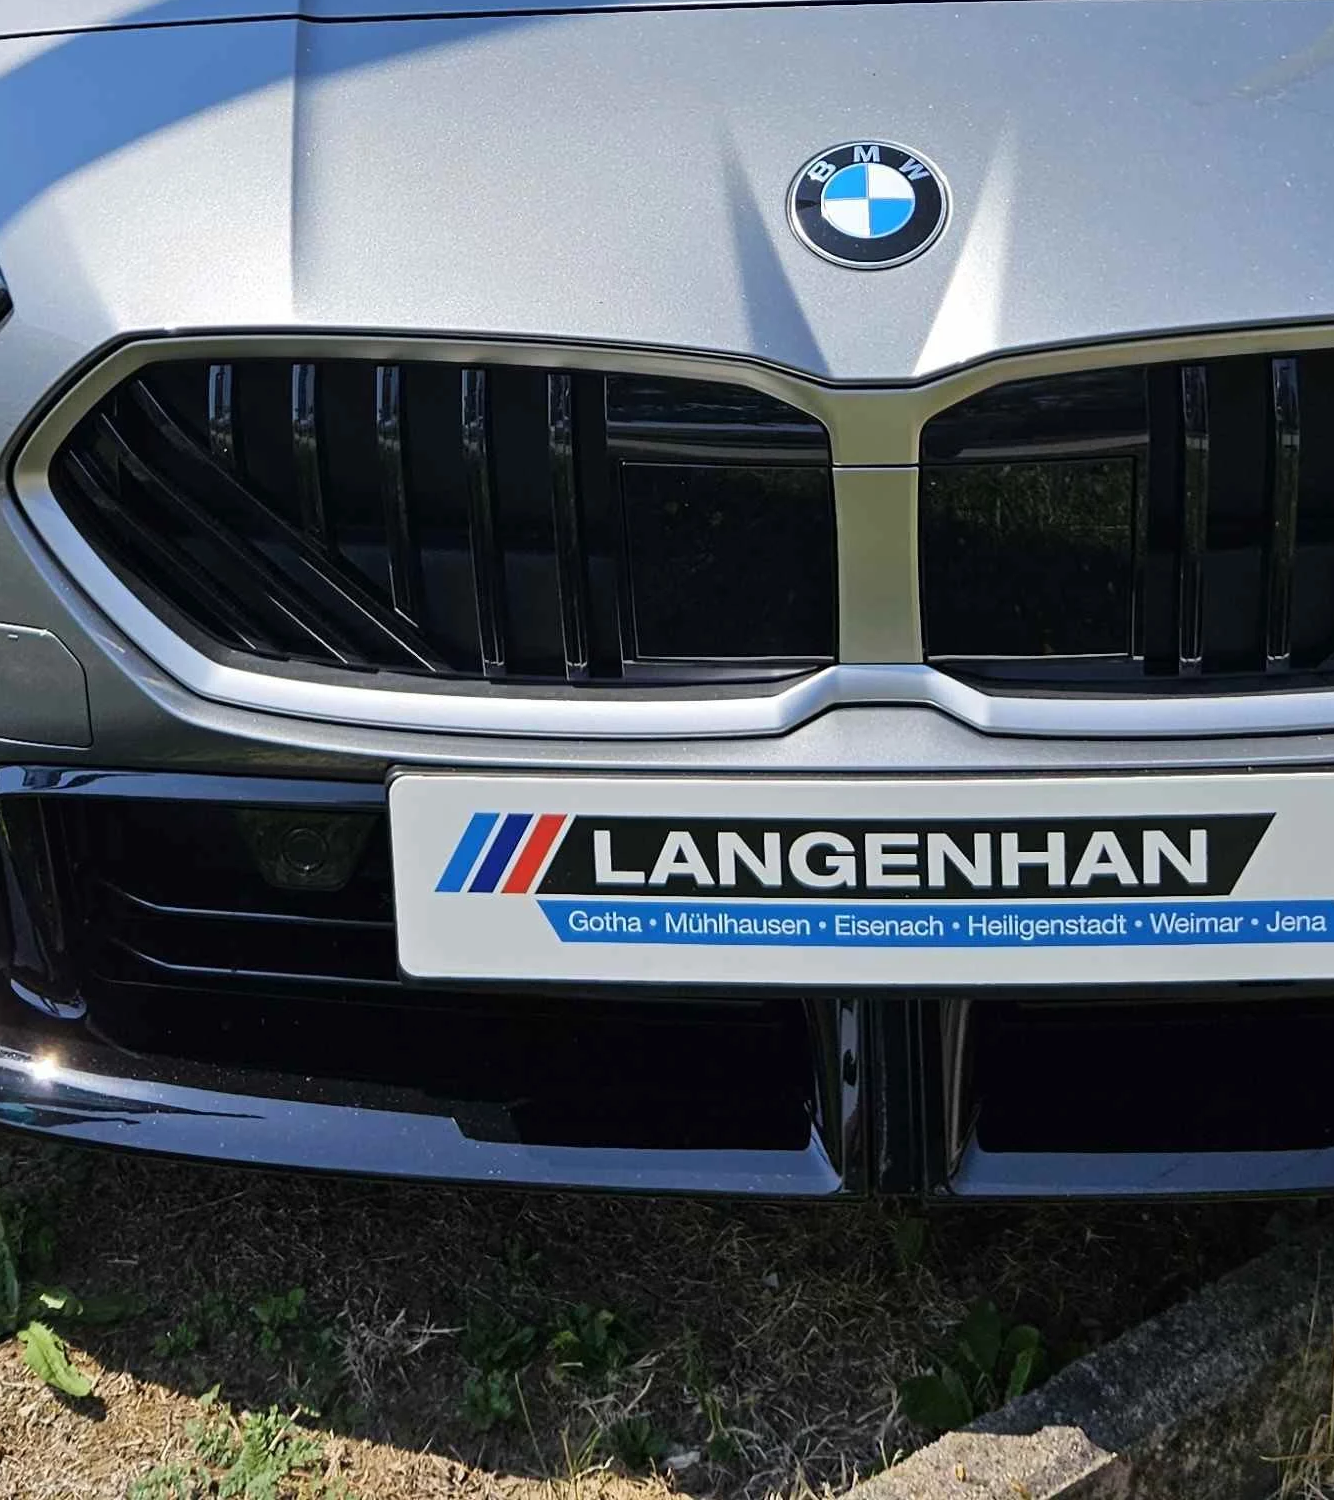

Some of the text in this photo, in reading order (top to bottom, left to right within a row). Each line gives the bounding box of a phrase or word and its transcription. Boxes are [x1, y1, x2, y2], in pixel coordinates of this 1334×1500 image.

[807, 145, 930, 184] BMW
[593, 828, 1208, 889] LANGENHAN
[568, 910, 1328, 941] Gotha Mühlhausen Eisenach Heiligenstadt Weimar Jena
